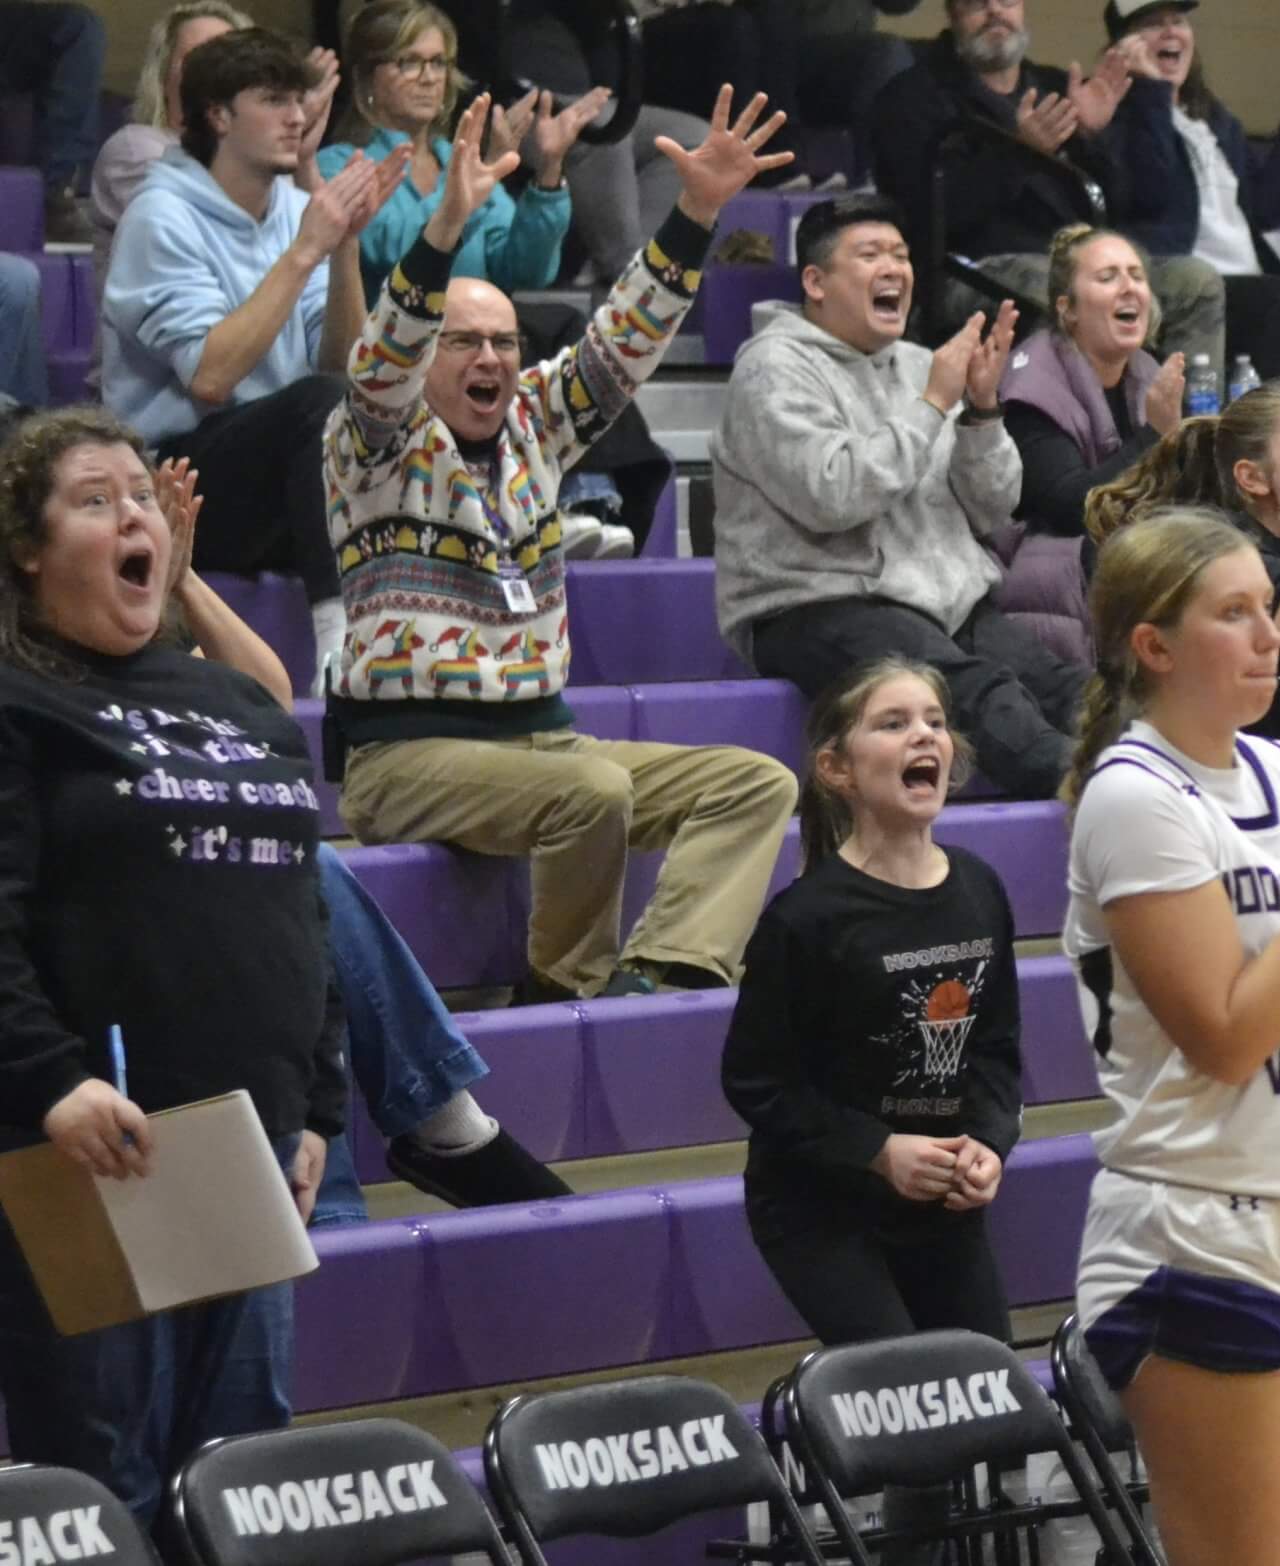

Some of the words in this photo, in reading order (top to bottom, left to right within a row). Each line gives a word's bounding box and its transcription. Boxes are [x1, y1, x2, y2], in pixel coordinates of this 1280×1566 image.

[204, 736, 267, 764] the
[138, 767, 230, 803] cheer
[238, 778, 320, 811] coach
[191, 825, 243, 861] it's
[251, 837, 292, 865] me
[830, 1368, 1022, 1439] NOOKSACK
[535, 1413, 740, 1491] NOOKSACK
[223, 1459, 449, 1537] NOOKSACK
